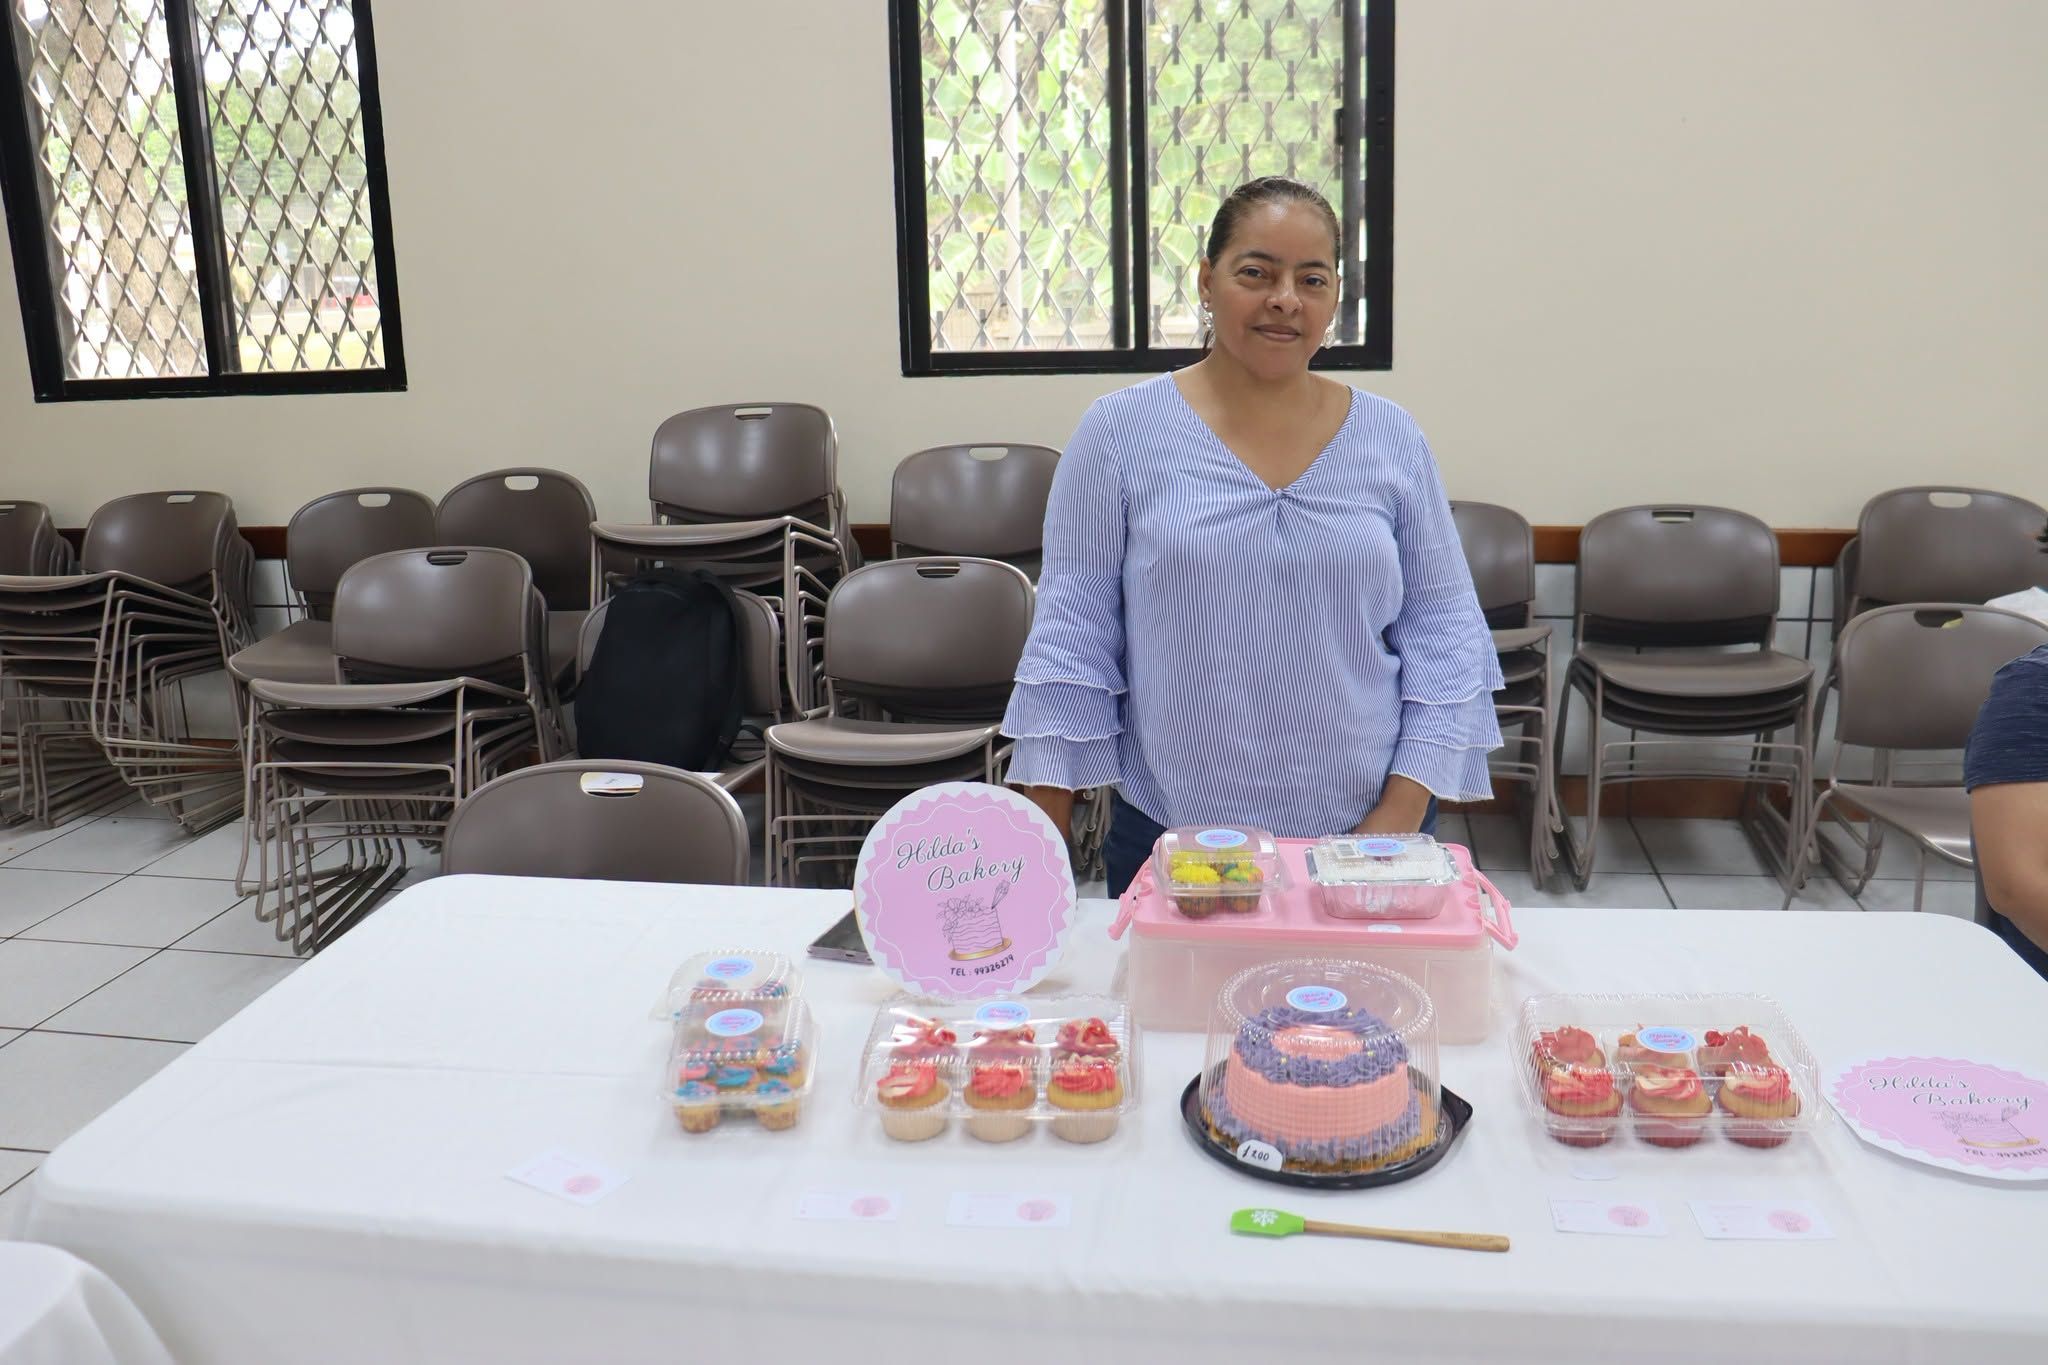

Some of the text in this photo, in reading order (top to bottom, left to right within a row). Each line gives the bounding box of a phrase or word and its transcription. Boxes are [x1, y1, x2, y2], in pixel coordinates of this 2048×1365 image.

[897, 828, 981, 870] Hilda's
[927, 854, 1026, 892] Bakery
[974, 953, 1014, 975] 99326279
[1869, 1075, 1971, 1091] Hilda's
[1912, 1091, 2032, 1111] Bakery
